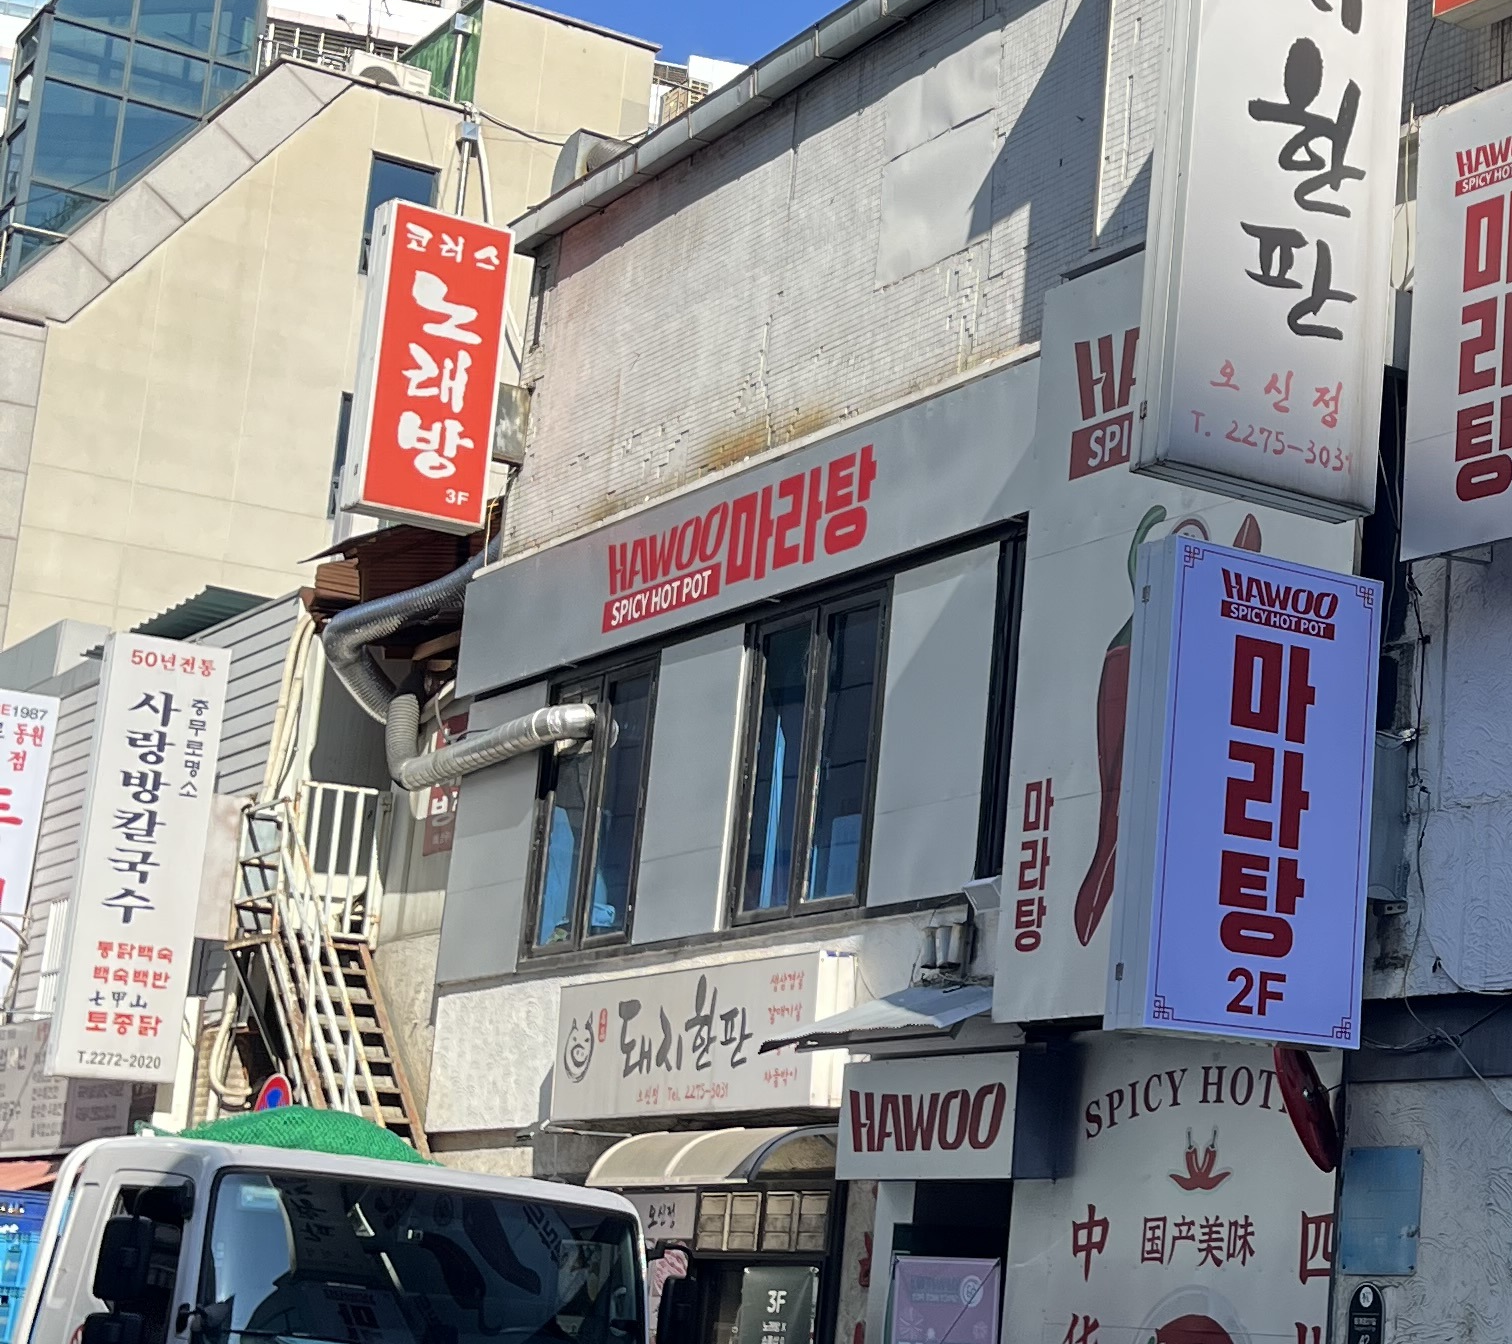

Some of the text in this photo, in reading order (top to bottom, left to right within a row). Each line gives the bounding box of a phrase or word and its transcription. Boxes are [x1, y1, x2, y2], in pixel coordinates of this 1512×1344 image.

[1462, 172, 1492, 193] SPICY
[405, 221, 500, 271] 코러스
[397, 269, 483, 480] 노래방
[1209, 359, 1344, 429] 오신정
[1088, 419, 1129, 467] SPI
[1191, 409, 1354, 475] T. 2275-3031
[444, 488, 470, 506] 3F
[725, 443, 878, 586] 마라탕
[608, 501, 729, 596] HAWOO
[611, 569, 712, 627] SPICY HOT POT
[1221, 567, 1339, 620] HAWOO
[1230, 604, 1326, 636] SPICY HOT POT
[131, 649, 216, 677] 50년전통
[0, 704, 48, 721] E1987
[101, 690, 182, 925] 사랑방칼국수
[1218, 634, 1316, 959] 마라탕
[1014, 776, 1054, 953] 마라탕
[89, 990, 148, 1009] 七甲山
[93, 966, 171, 989] 백숙백반
[1225, 967, 1287, 1017] 2F
[86, 1011, 162, 1037] 토종닭
[618, 973, 753, 1078] 돼지한판
[77, 1050, 161, 1069] T.2272-2020
[850, 1081, 1008, 1153] HAWOO
[1085, 1065, 1278, 1140] SPICY HOT
[1141, 1214, 1256, 1268] 国产美味
[766, 1289, 787, 1314] 3F
